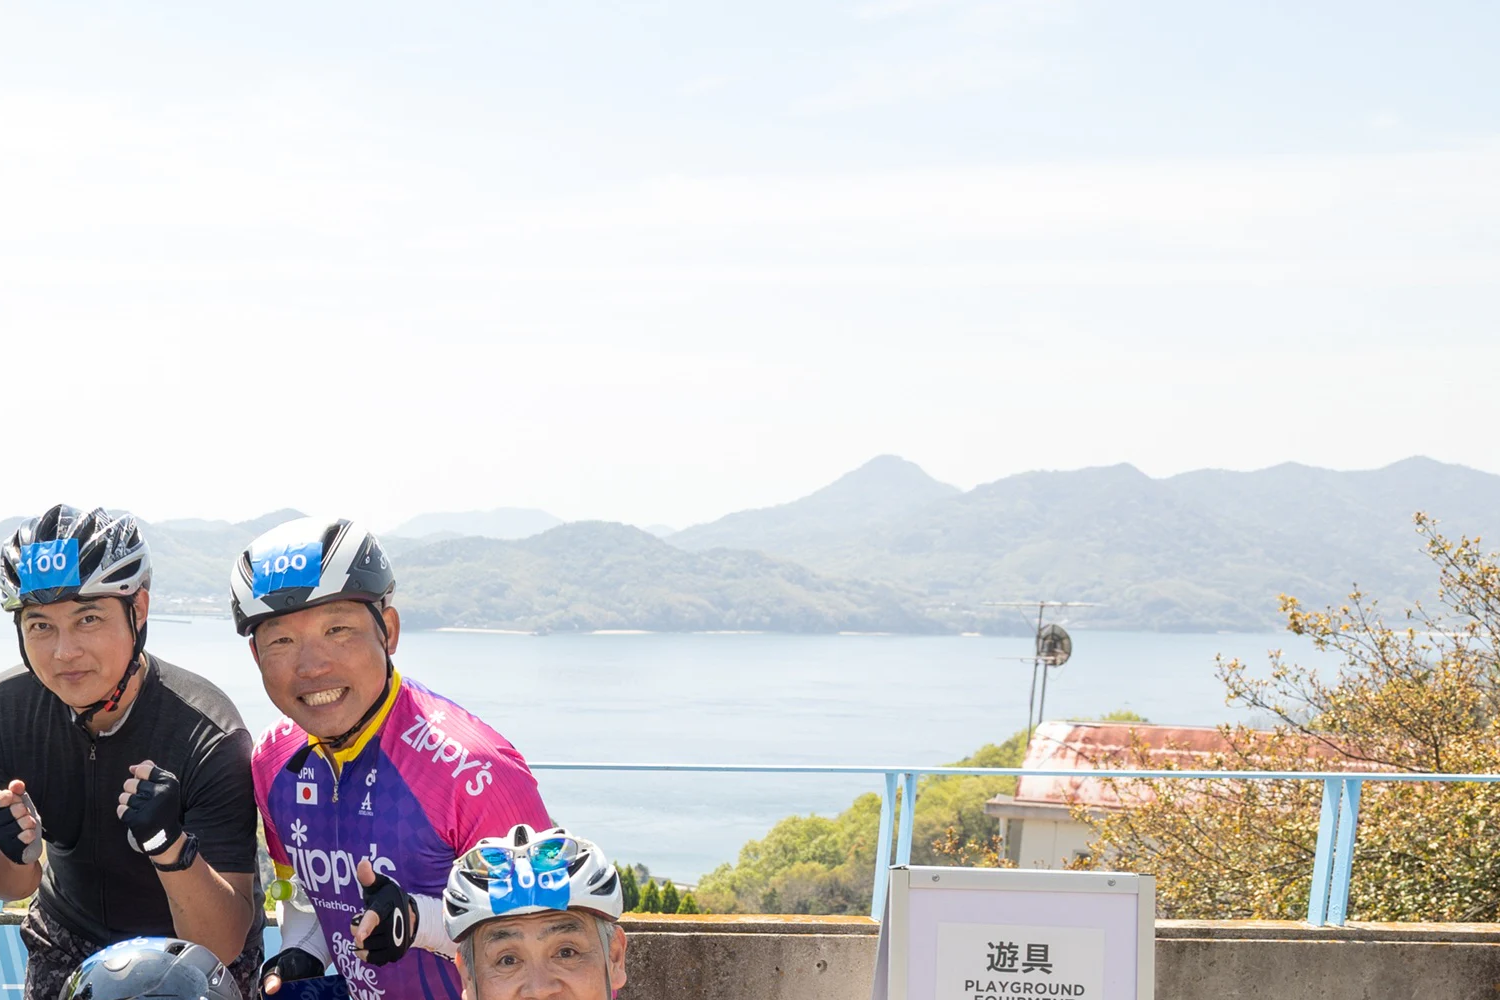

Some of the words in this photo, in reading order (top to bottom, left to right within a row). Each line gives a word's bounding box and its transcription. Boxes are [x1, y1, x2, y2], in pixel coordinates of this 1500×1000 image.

[26, 552, 67, 575] 100
[262, 554, 307, 577] 100
[400, 713, 493, 797] zippy's
[311, 897, 357, 914] Triathlon
[337, 953, 379, 986] Bike
[986, 941, 1053, 975] 遊具
[964, 979, 1085, 997] PLAYGROUND
